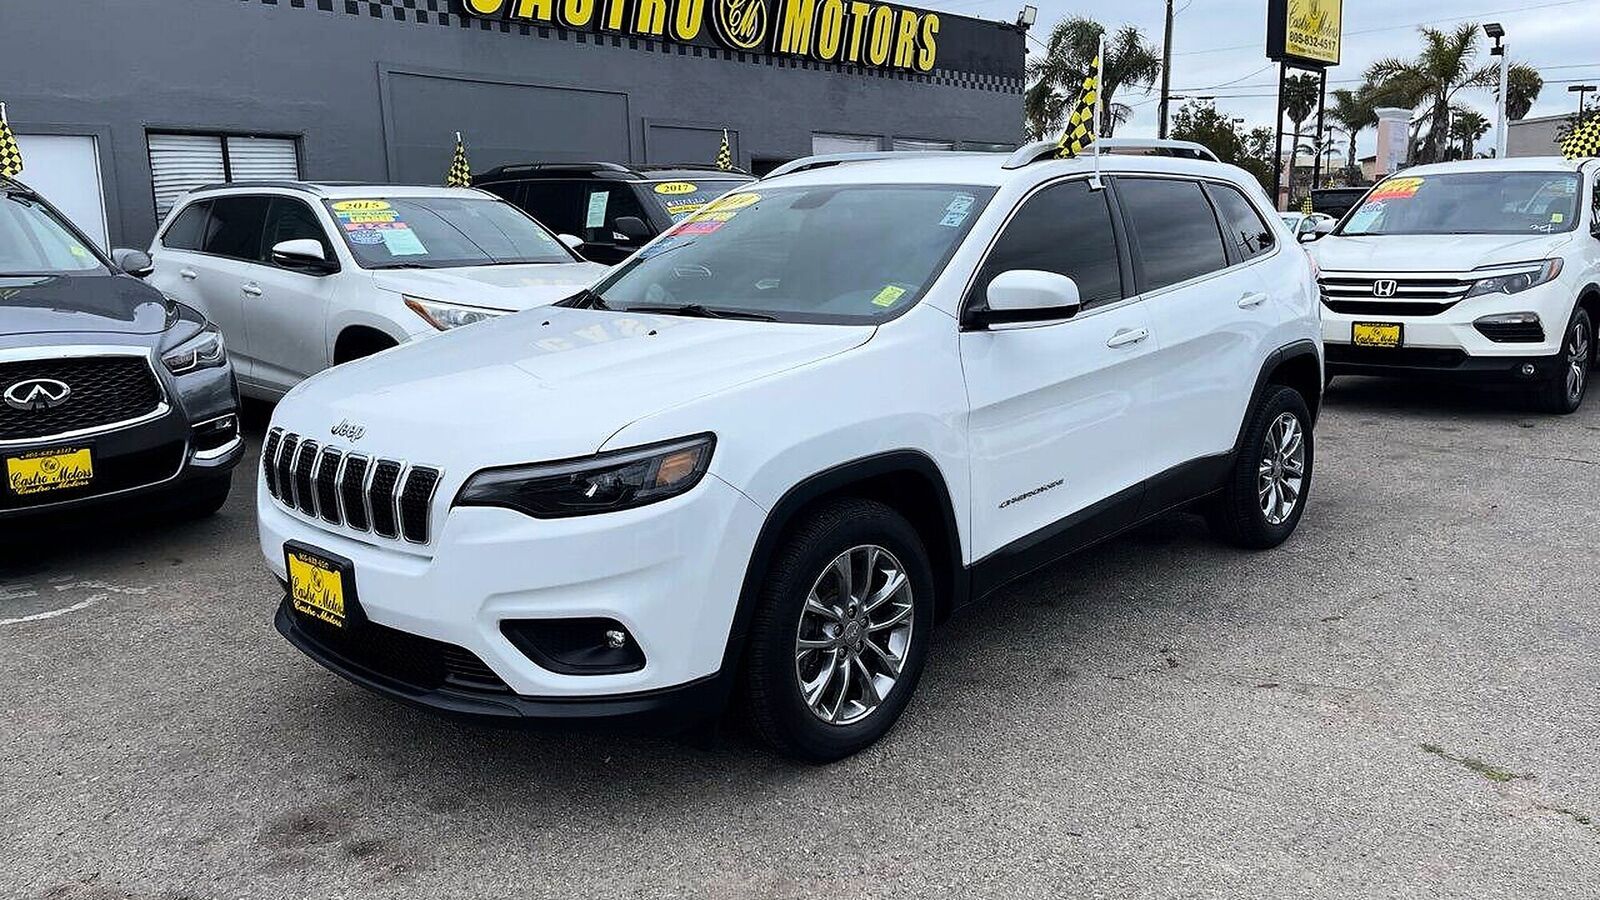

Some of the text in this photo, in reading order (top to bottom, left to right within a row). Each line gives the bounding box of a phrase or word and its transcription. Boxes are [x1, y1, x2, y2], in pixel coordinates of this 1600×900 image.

[780, 0, 940, 71] MOTORS
[664, 184, 689, 192] 2017
[345, 202, 380, 210] 2015
[331, 418, 367, 443] Jeep
[11, 465, 92, 489] Castro Motors
[292, 575, 316, 604] Castro
[293, 599, 342, 628] Castro Motors
